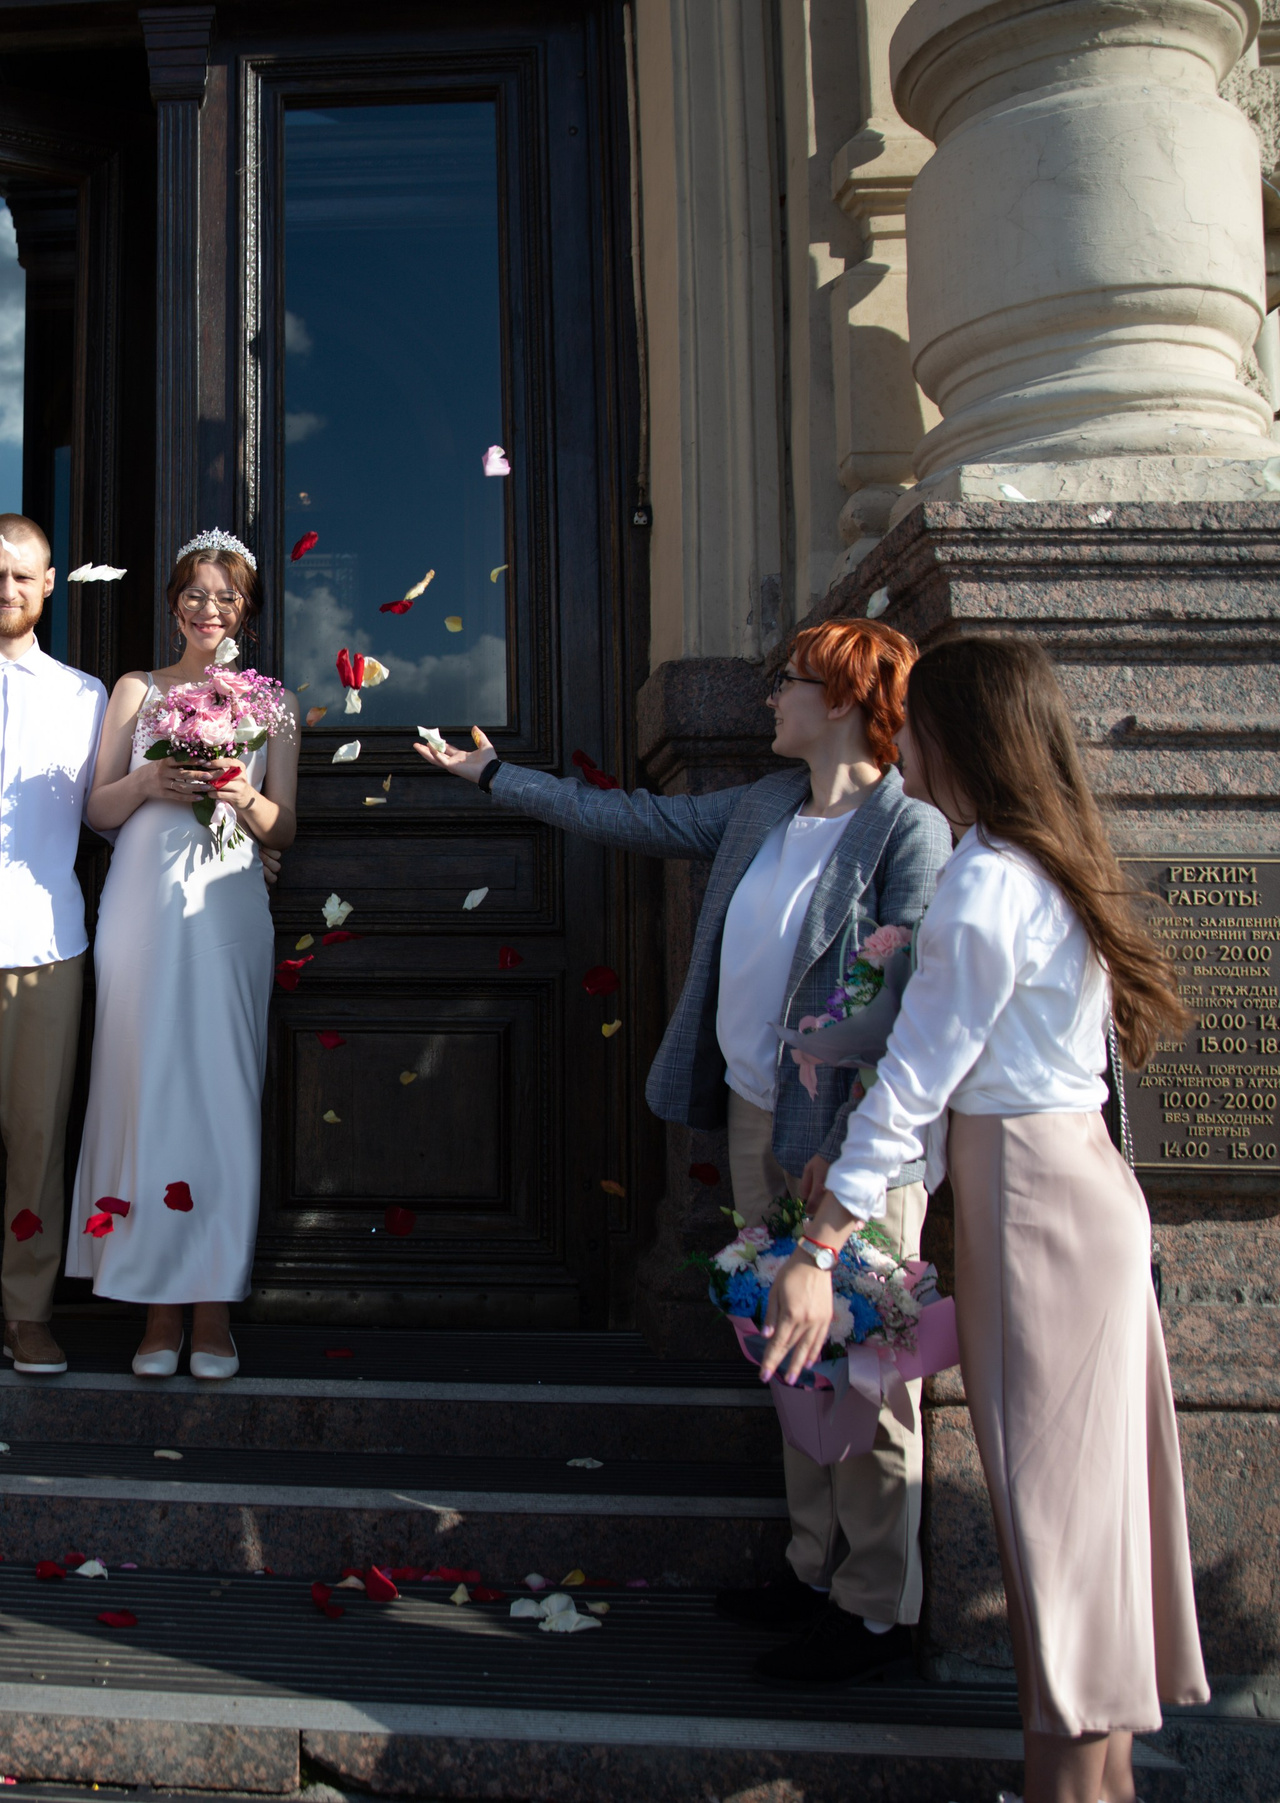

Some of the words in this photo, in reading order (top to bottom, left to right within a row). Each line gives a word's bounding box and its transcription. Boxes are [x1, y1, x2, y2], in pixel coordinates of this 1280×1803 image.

[1169, 866, 1257, 883] РЕЖИМ
[1167, 889, 1262, 906] РАБОТЫ:
[1148, 916, 1194, 927] ПРИЕМ
[1200, 915, 1280, 928] ЗАЯВЛЕНИЙ
[1152, 929, 1246, 940] ЗАКЛЮЧЕНИИ
[1193, 965, 1270, 978] ВЫХОДНЫХ
[1211, 985, 1278, 998] ГРАЖДАН
[1243, 998, 1280, 1010] ОТДЕ
[1200, 1013, 1280, 1031] 10.00-14.
[1156, 1042, 1187, 1052] ВЕРГ
[1200, 1036, 1280, 1054] 15.00-18.
[1147, 1063, 1202, 1075] ВЫДАЧА
[1209, 1064, 1280, 1076] ПОВТОРНЫ
[1139, 1076, 1231, 1088] ДОКУМЕНТОВ
[1234, 1077, 1244, 1088] В
[1247, 1078, 1280, 1089] АРХИ
[1164, 1112, 1190, 1123] БЕЗ
[1195, 1113, 1274, 1126] ВЫХОДНЫХ
[1187, 1126, 1251, 1137] ПЕРЕРЫВ
[1162, 1140, 1210, 1159] 14.00
[1230, 1142, 1278, 1160] 15.00
